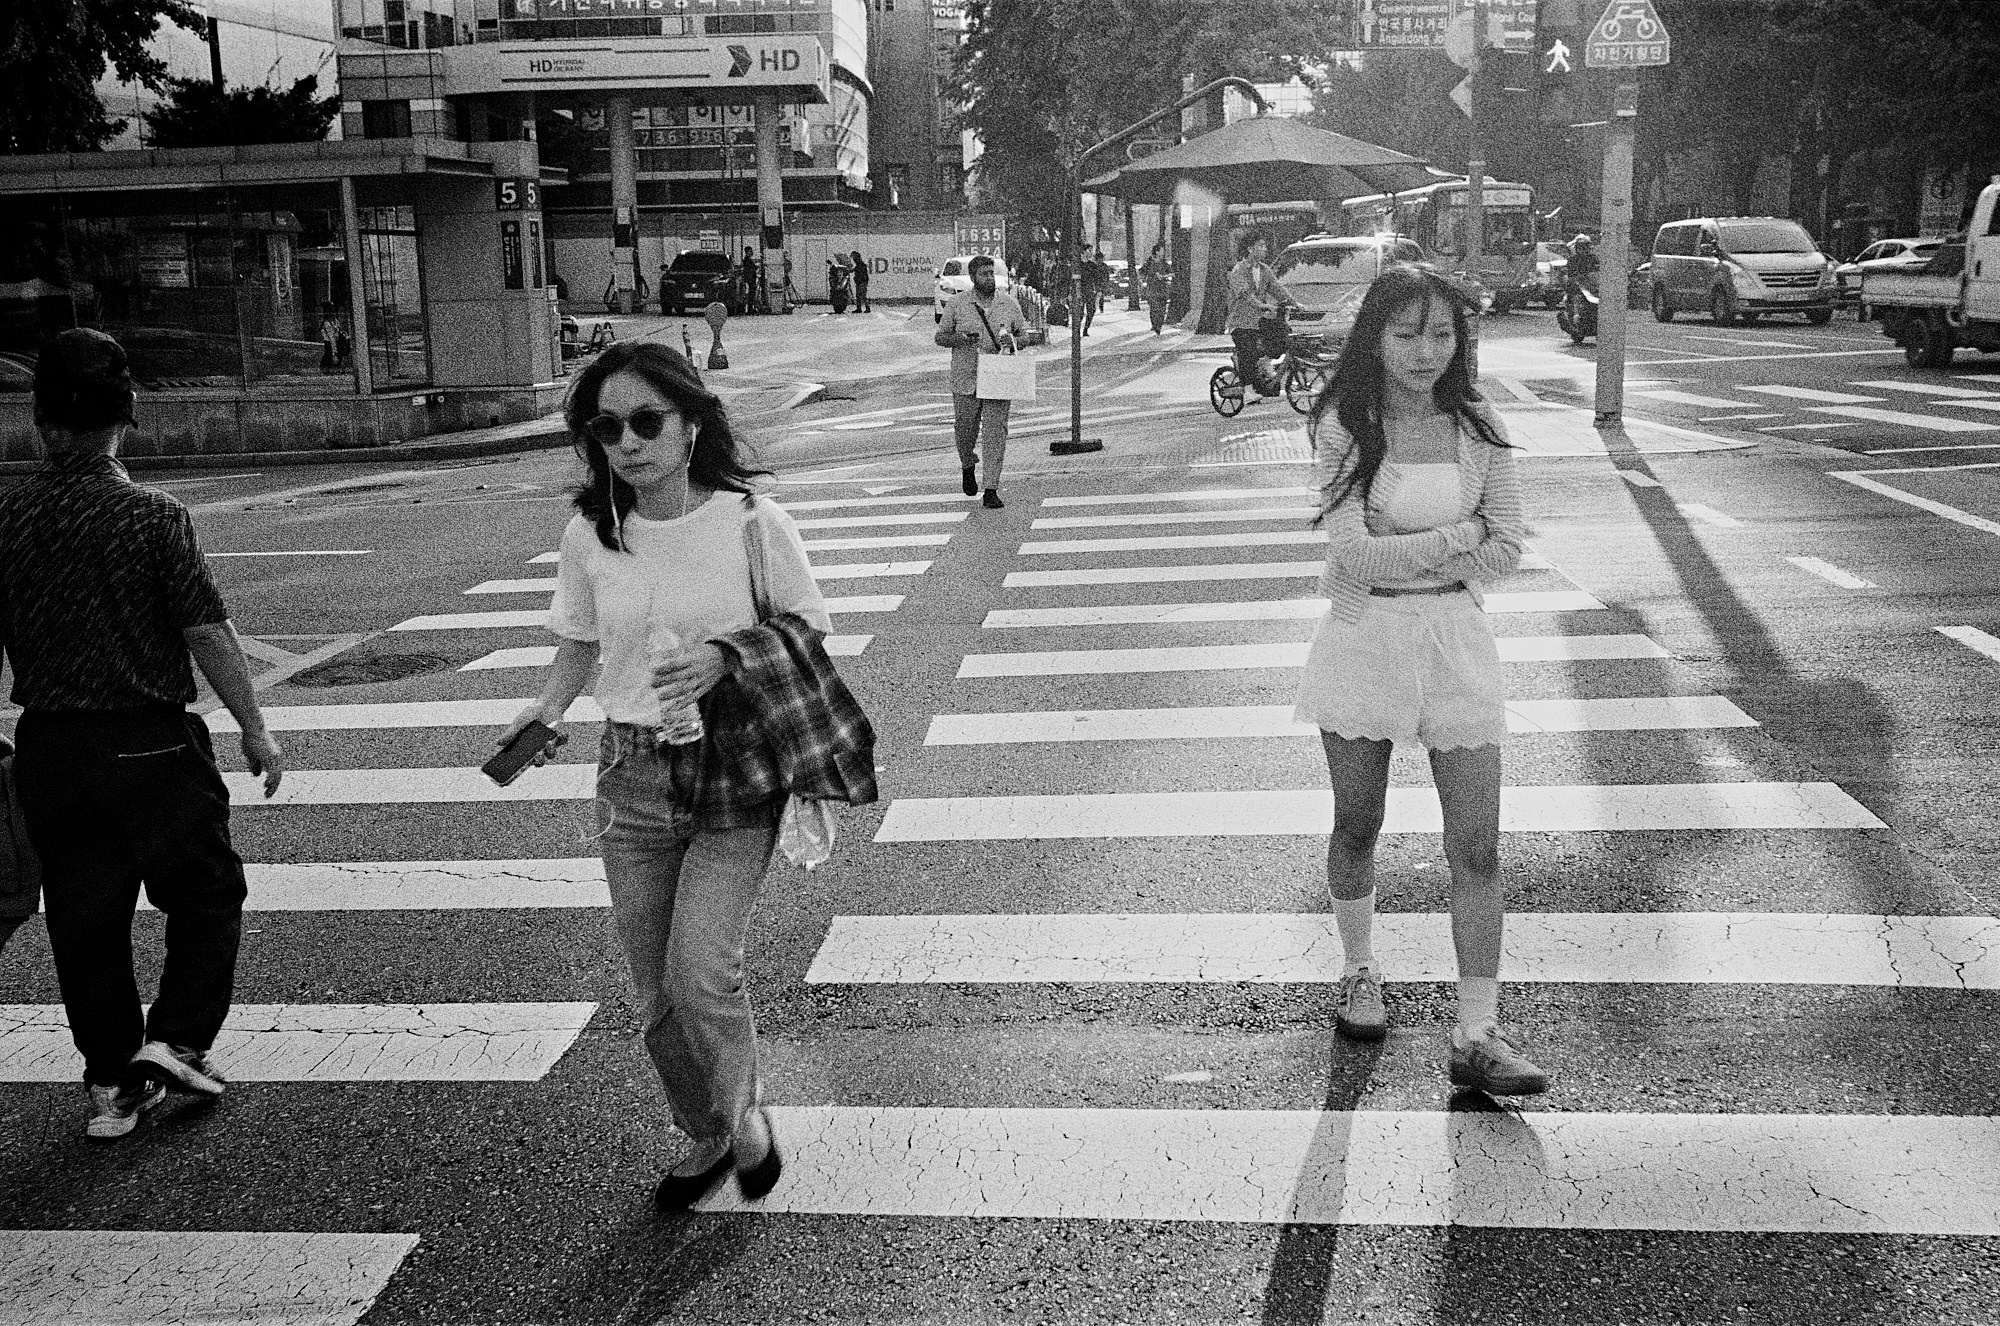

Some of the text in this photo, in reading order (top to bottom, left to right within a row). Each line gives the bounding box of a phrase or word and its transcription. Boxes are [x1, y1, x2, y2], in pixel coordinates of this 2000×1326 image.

[760, 49, 801, 72] HD
[1594, 45, 1662, 61] 자전거횡단
[529, 59, 553, 73] HD
[502, 182, 517, 204] 5
[527, 182, 537, 204] 5
[959, 228, 1002, 242] 1635
[892, 257, 934, 266] HYUNDAI
[892, 266, 934, 275] OILBANK
